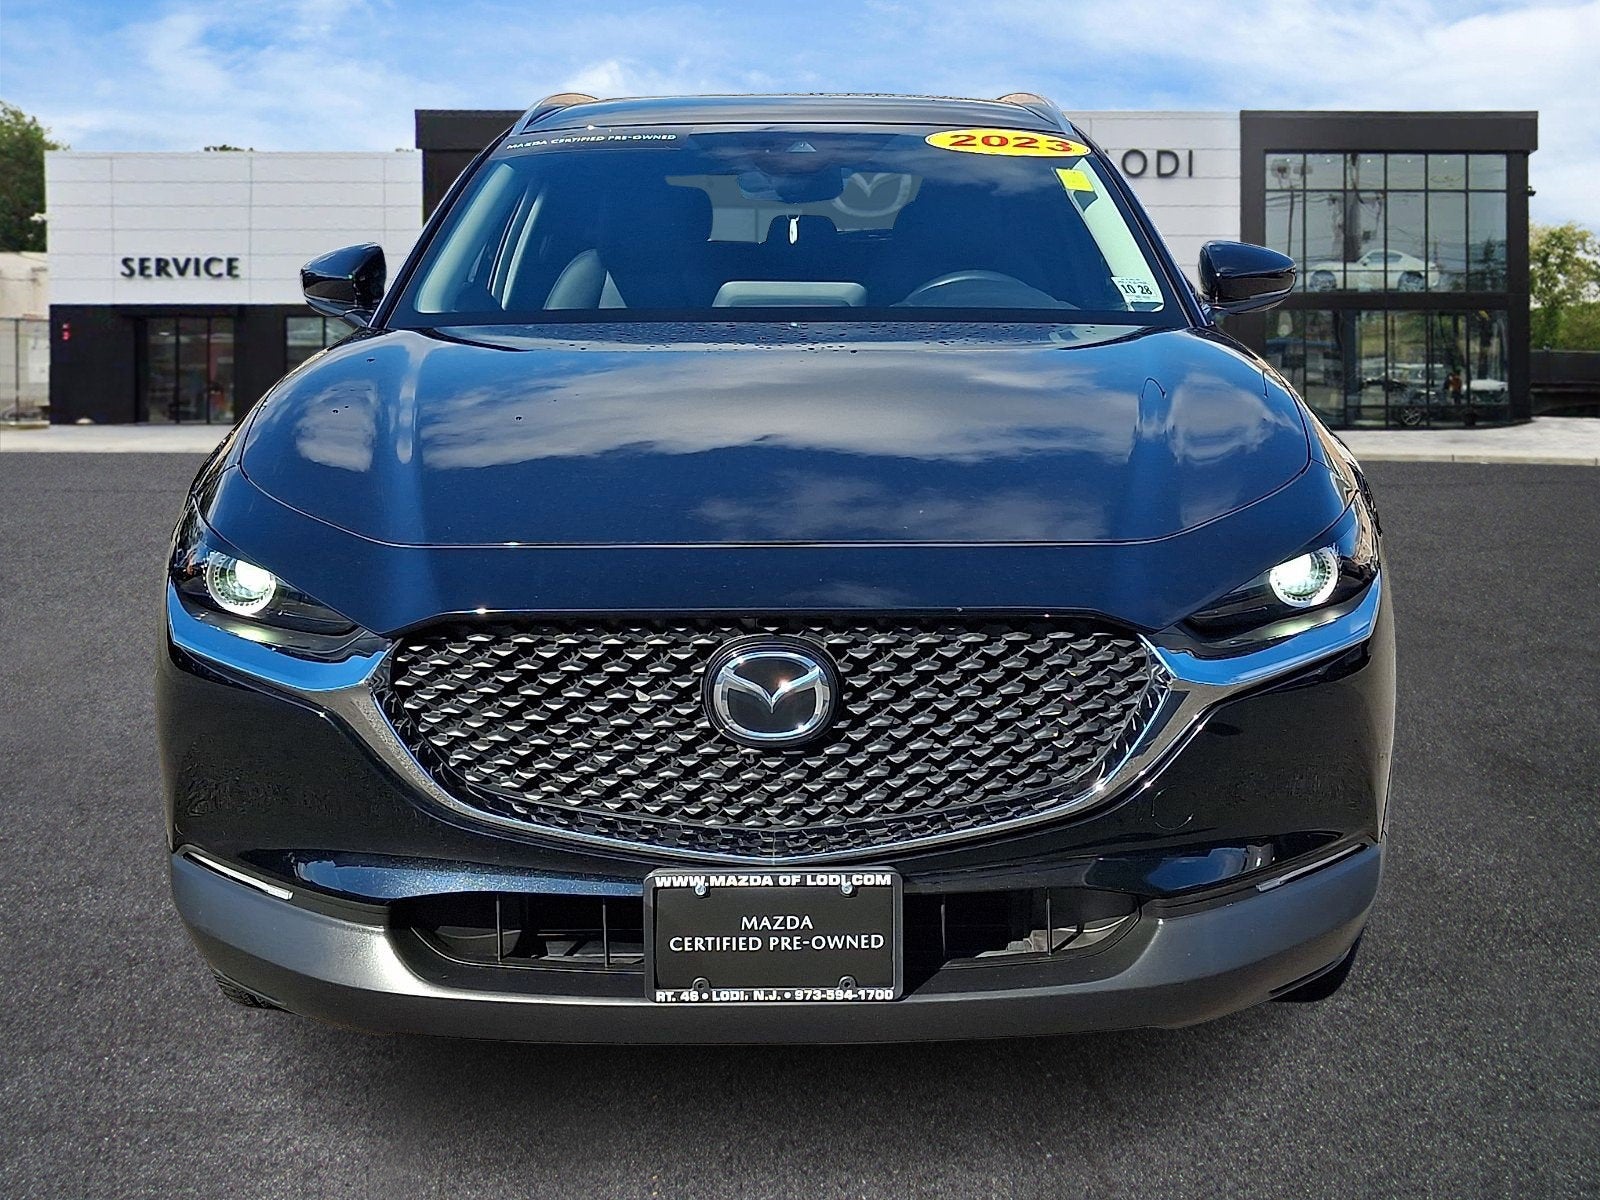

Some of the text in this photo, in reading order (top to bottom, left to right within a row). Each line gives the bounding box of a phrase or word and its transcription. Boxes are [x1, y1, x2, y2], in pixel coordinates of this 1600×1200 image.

[551, 136, 605, 144] CERTIFIED
[948, 134, 1073, 152] 2023
[1104, 149, 1193, 178] ODI
[120, 257, 240, 278] SERVICE
[1120, 284, 1153, 295] 10 28
[655, 875, 774, 888] WWW.MAZDA
[778, 874, 802, 886] OF
[740, 915, 814, 931] MAZDA
[669, 933, 885, 952] CERTIFIED PRE-OWNED
[655, 991, 677, 1002] RT.
[753, 990, 782, 1001] N.J.
[794, 989, 894, 1001] 973-594-1700
